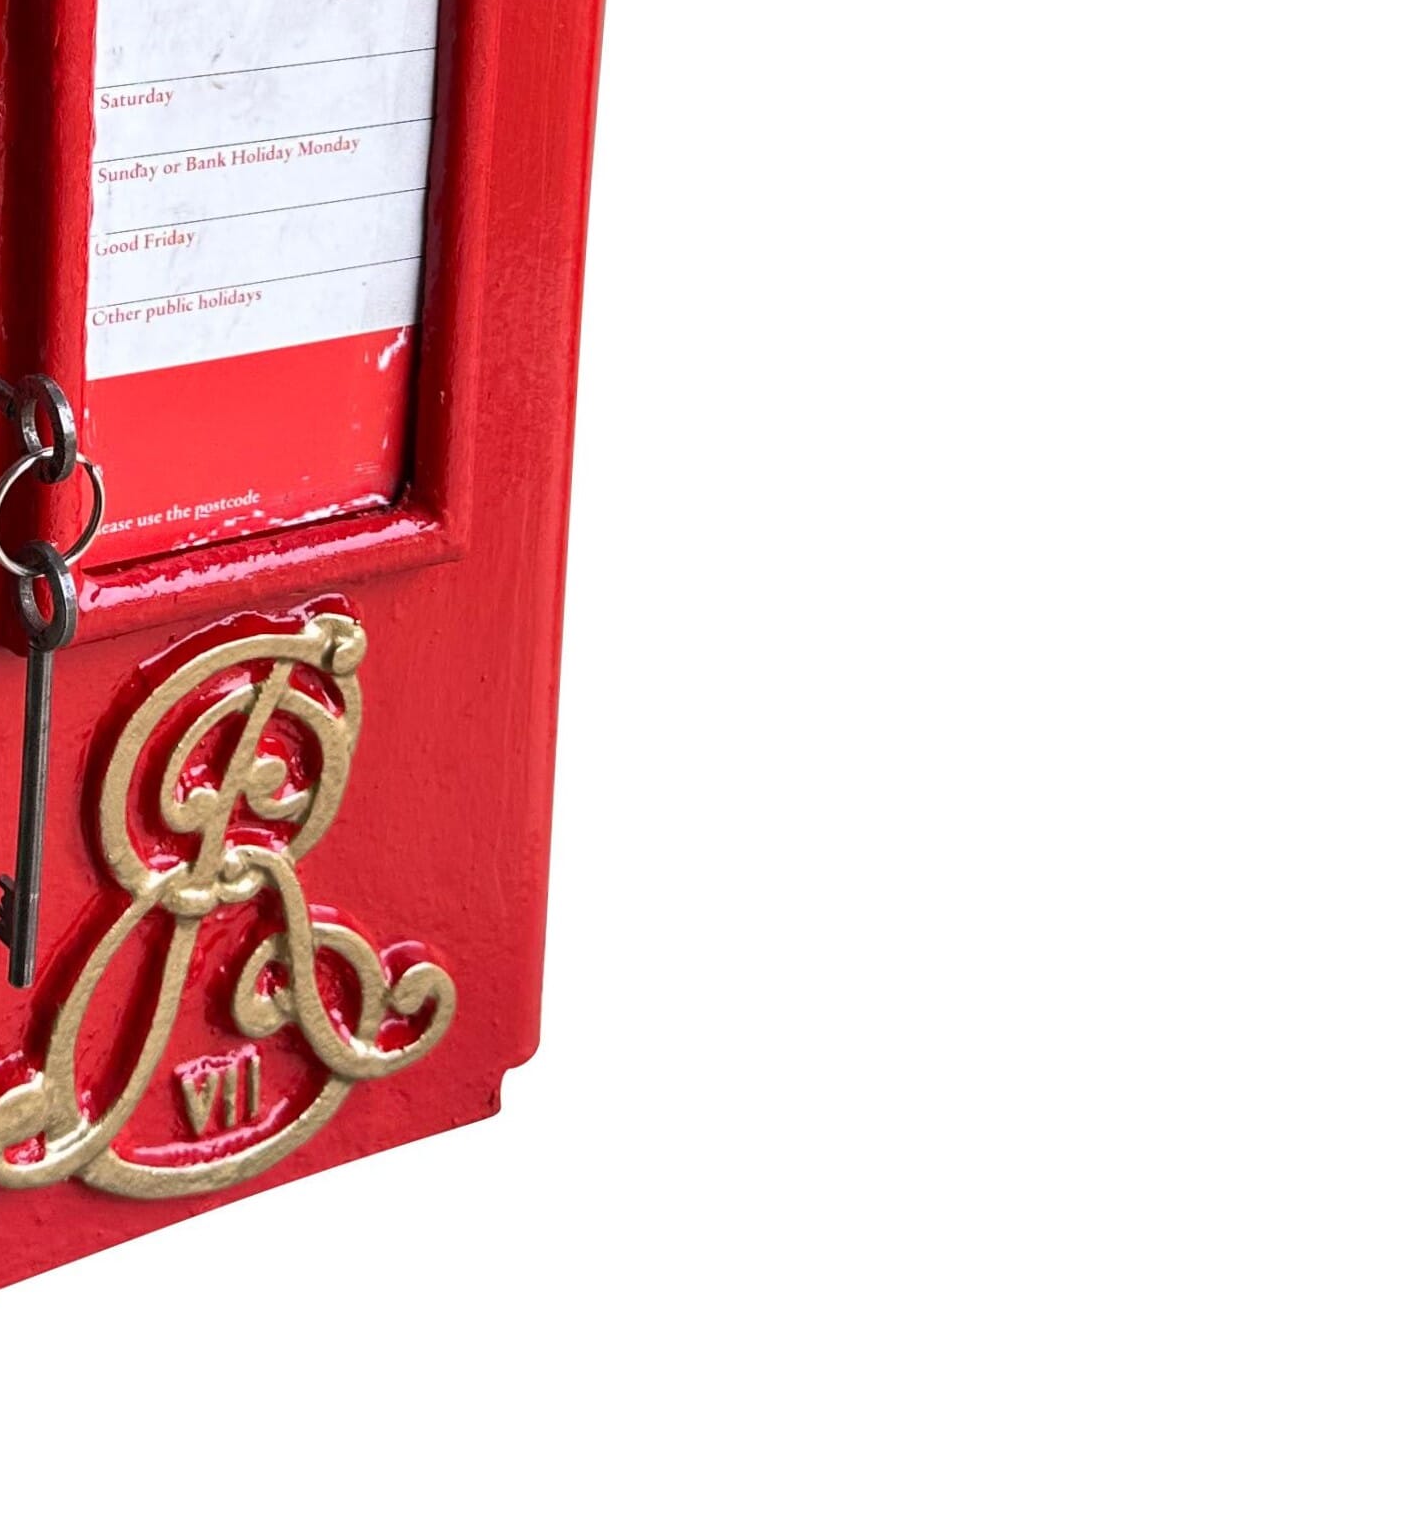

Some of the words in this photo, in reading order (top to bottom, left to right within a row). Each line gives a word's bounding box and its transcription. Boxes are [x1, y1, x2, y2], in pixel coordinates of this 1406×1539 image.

[100, 87, 174, 110] Saturday
[97, 163, 157, 184] Sunday
[163, 163, 181, 175] or
[186, 152, 227, 172] Bank
[231, 146, 294, 166] Holiday
[297, 136, 360, 159] Monday
[95, 234, 139, 257] Good
[143, 228, 196, 249] Friday
[92, 308, 141, 327] Other
[146, 297, 194, 323] public
[198, 287, 263, 310] holidays
[137, 513, 163, 528] use
[166, 503, 192, 522] the
[194, 488, 261, 521] postcode
[180, 1056, 260, 1134] VII
